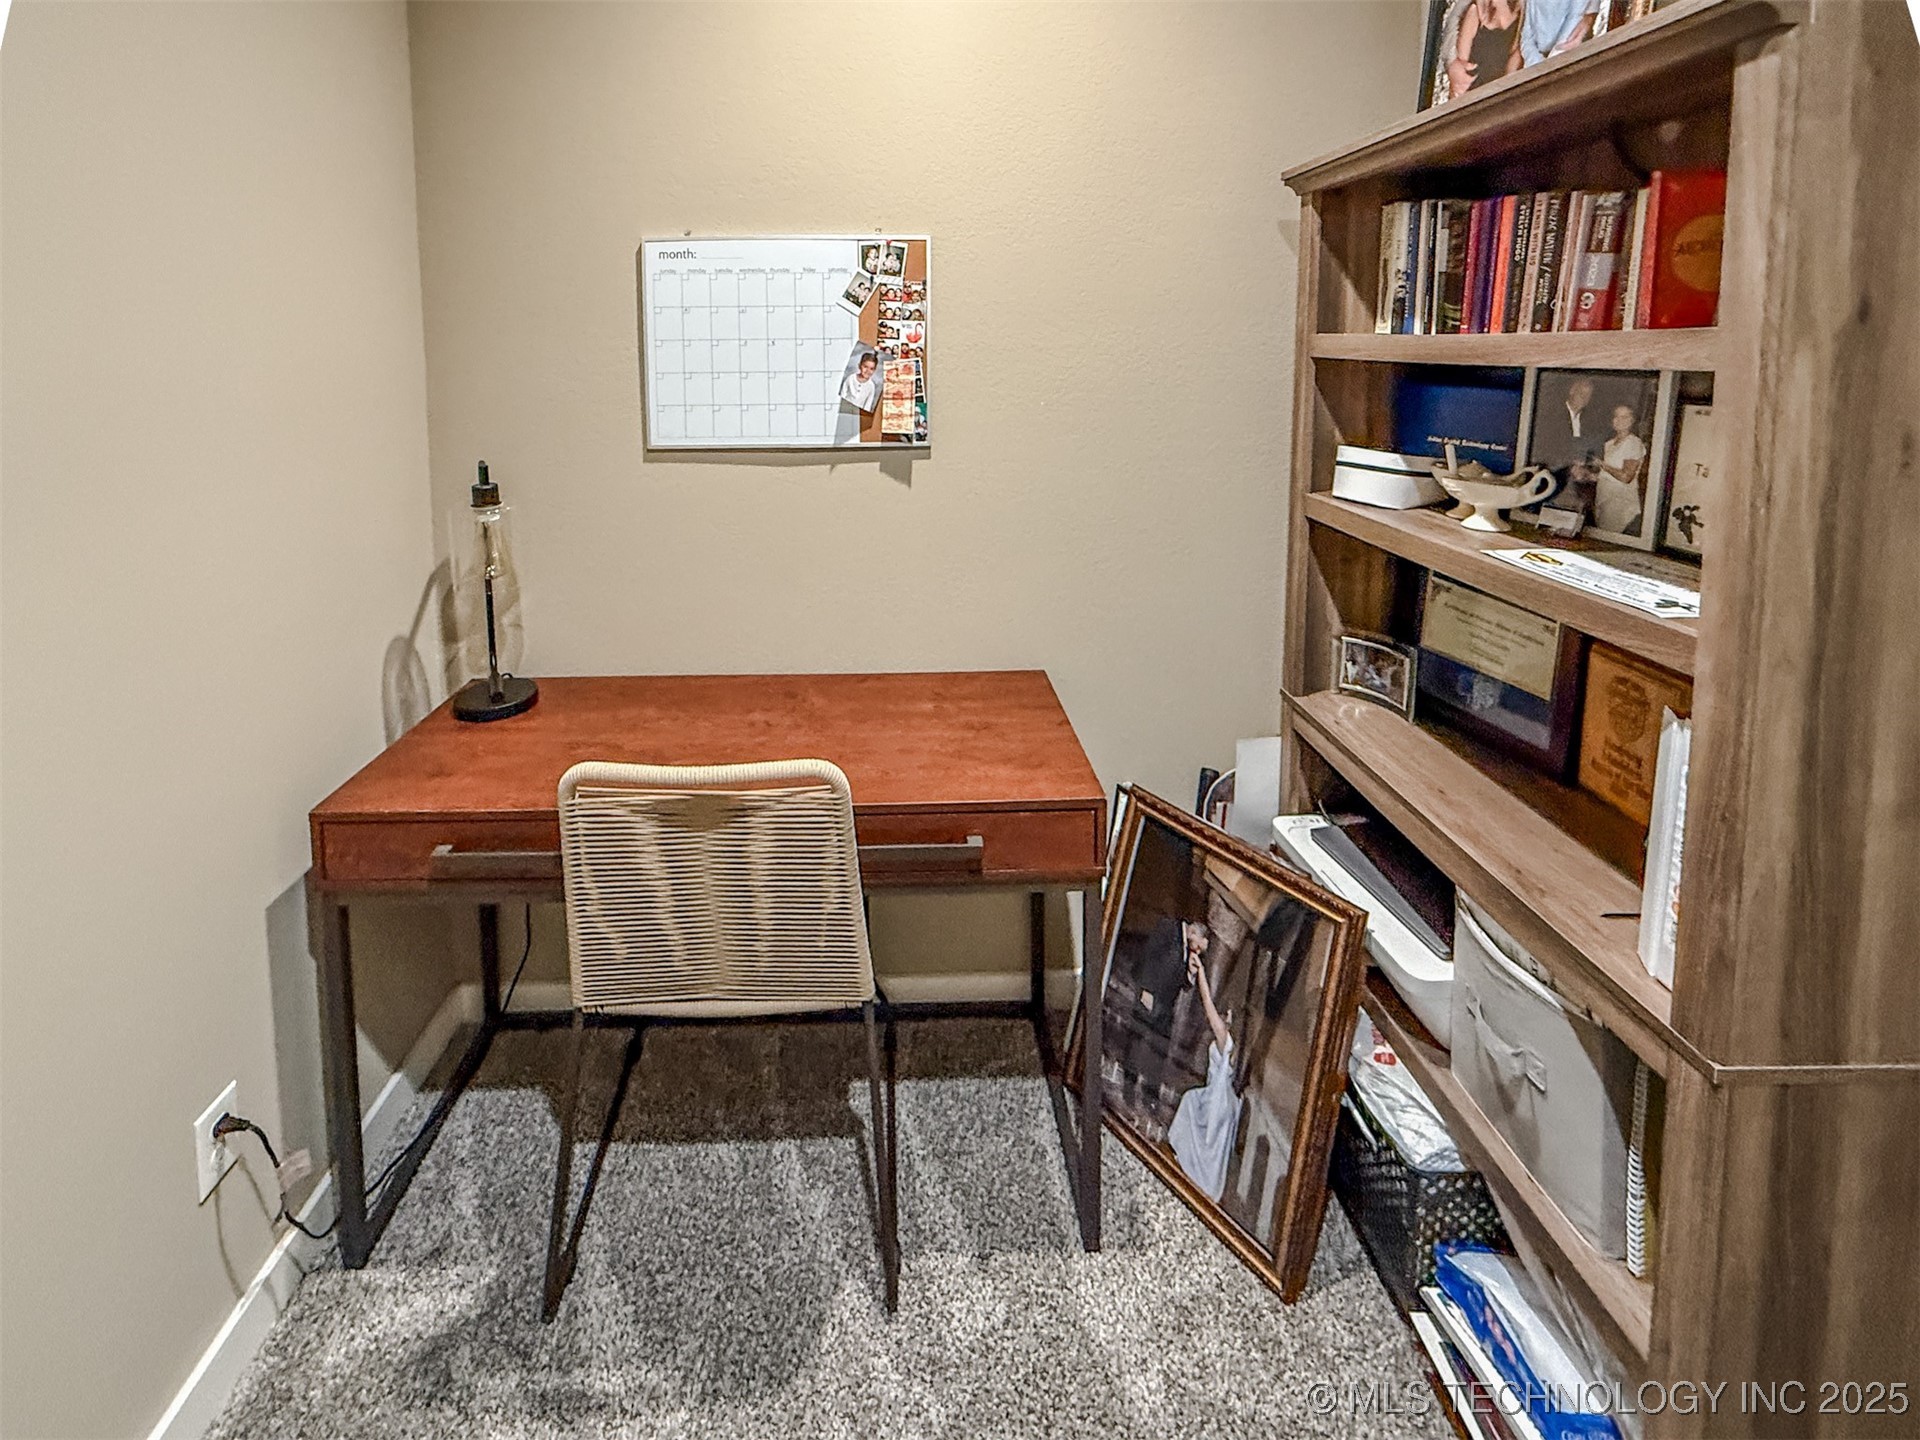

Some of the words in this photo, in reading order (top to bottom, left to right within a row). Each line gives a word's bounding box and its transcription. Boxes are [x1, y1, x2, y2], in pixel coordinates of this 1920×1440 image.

[1517, 204, 1528, 236] EVELYN
[1602, 215, 1614, 252] NURSING
[658, 248, 697, 259] month:
[1514, 237, 1523, 262] HUGO
[1531, 233, 1540, 254] WITH
[1542, 232, 1556, 264] NATION
